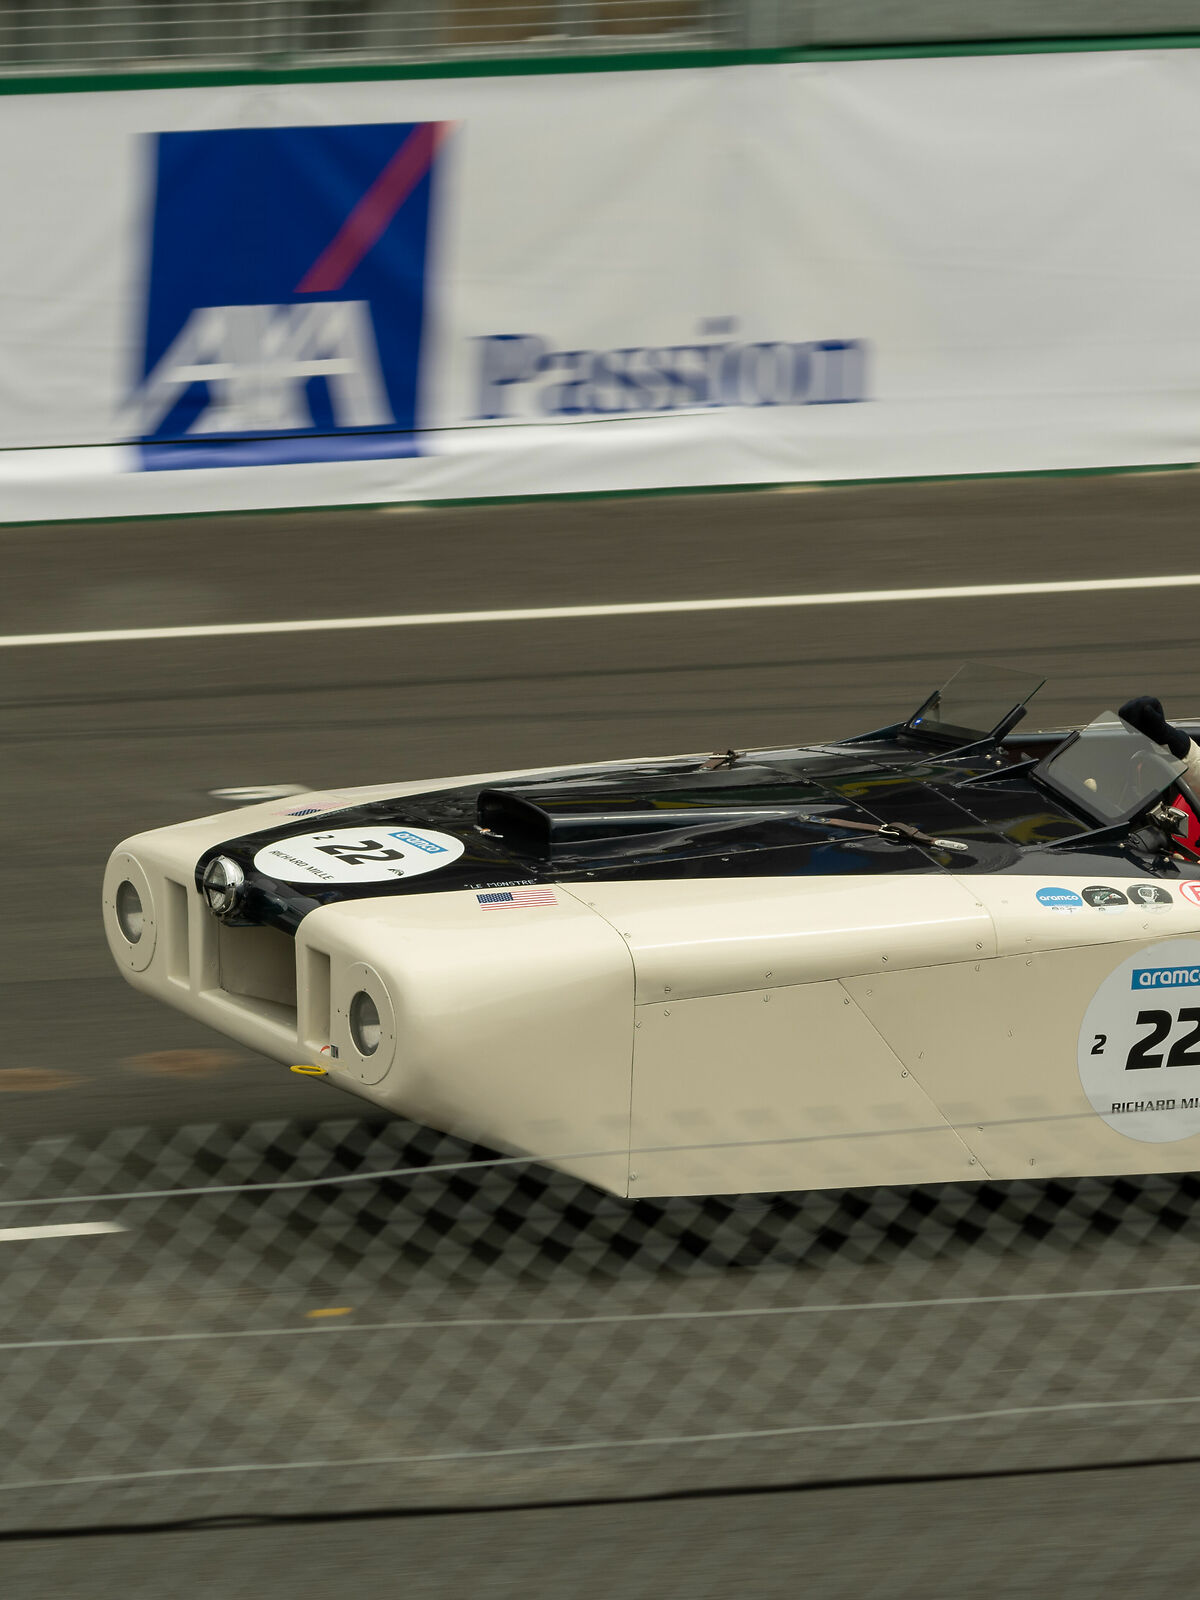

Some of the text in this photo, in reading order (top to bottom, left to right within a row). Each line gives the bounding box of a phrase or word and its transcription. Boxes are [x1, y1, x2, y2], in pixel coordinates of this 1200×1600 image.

[127, 300, 396, 434] AXA
[472, 316, 876, 420] Passion
[269, 849, 335, 881] RICHARD MILLE
[313, 839, 405, 866] 22
[1039, 894, 1079, 902] aramco
[1090, 1034, 1107, 1055] 2
[1111, 1099, 1176, 1114] RICHARD
